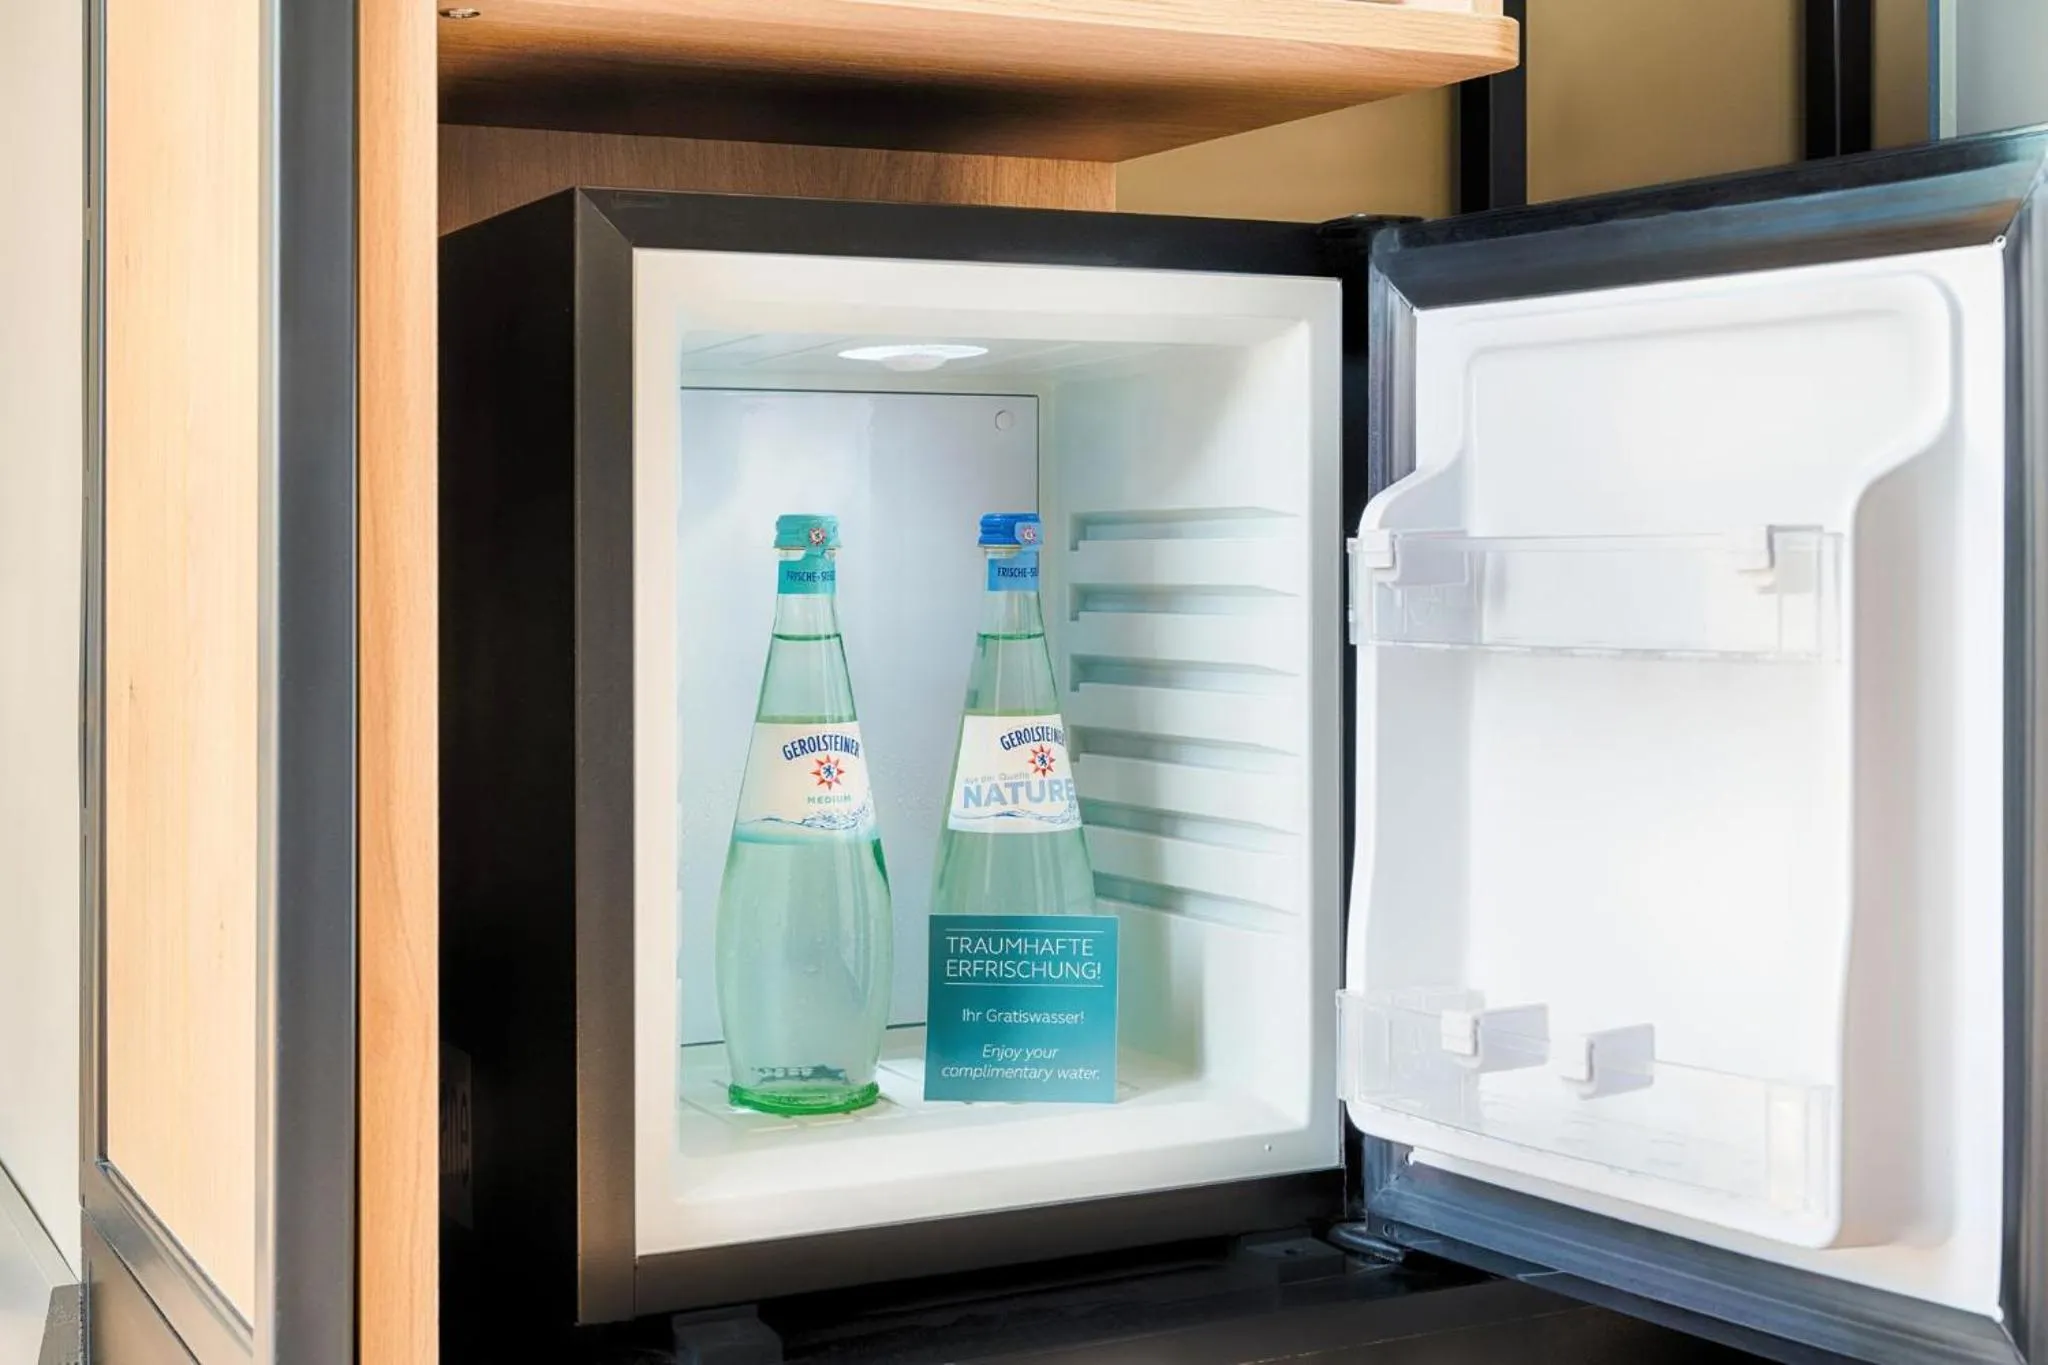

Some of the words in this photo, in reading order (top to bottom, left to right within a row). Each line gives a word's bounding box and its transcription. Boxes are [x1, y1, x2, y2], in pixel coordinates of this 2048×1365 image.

[806, 795, 852, 805] MEDIUM
[945, 936, 1094, 957] TRAUMHAFTE
[945, 959, 1102, 980] ERFRISCHUNG!
[962, 1008, 982, 1022] Ihr
[986, 1008, 1084, 1024] Gratiswasser!
[982, 1043, 1025, 1061] Enjoy
[1025, 1047, 1059, 1060] your
[941, 1064, 1055, 1082] complimentary
[1057, 1067, 1100, 1080] water.
